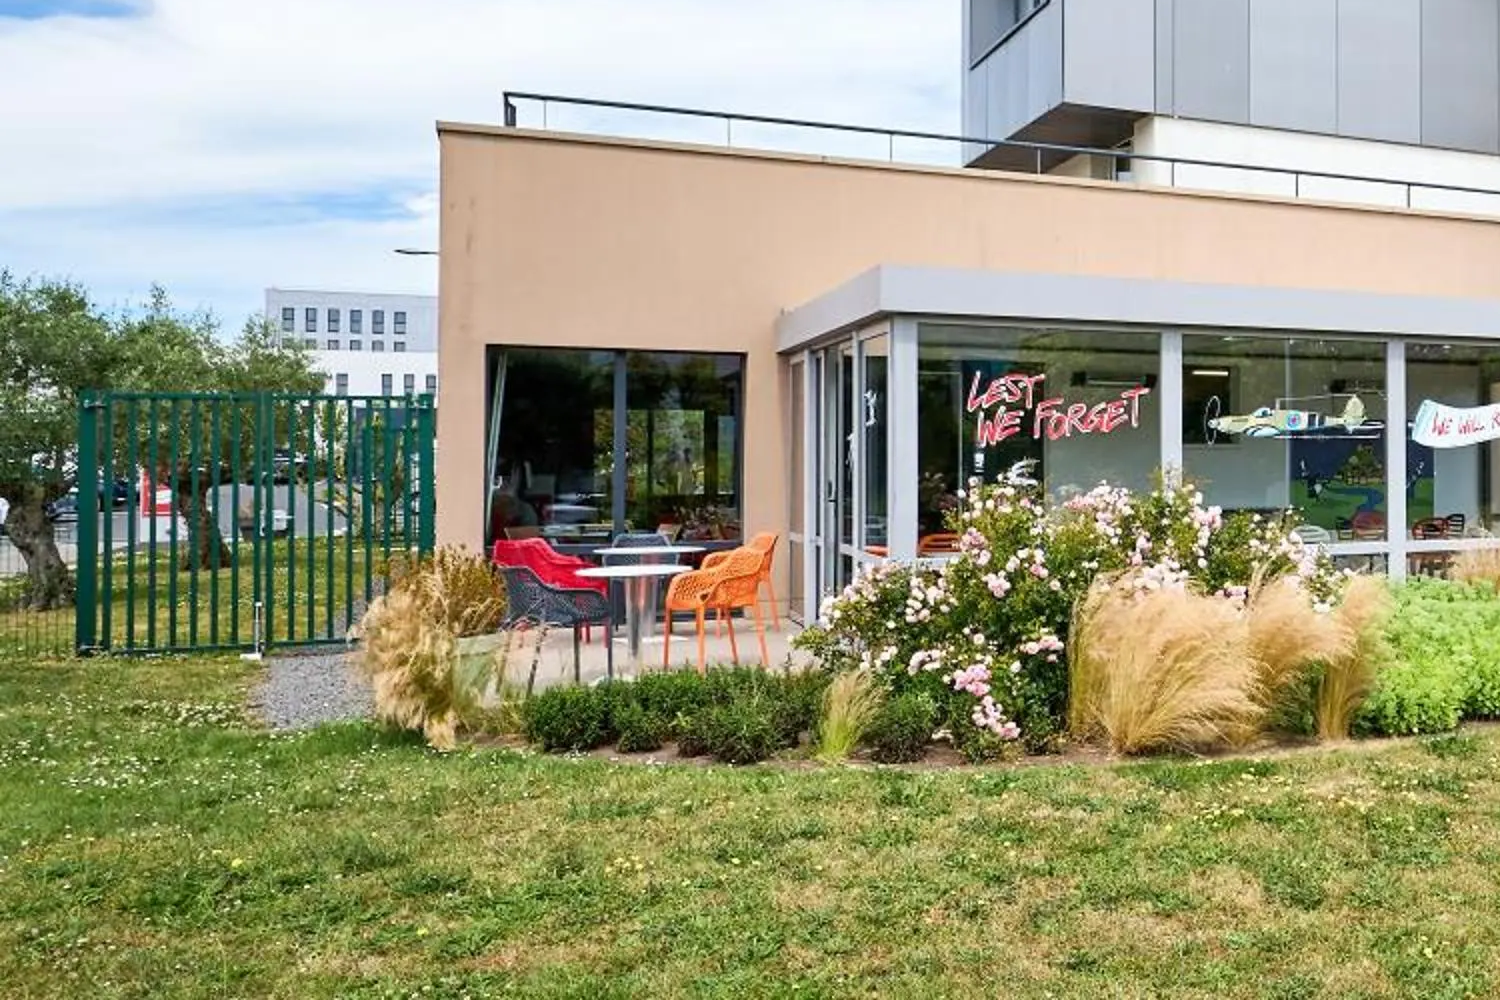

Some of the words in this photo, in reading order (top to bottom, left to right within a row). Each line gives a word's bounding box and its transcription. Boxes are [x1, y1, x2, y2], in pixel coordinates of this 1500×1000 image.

[967, 370, 1046, 412] LEST
[976, 405, 1025, 447] WE
[1033, 384, 1152, 441] FORGET
[1431, 410, 1454, 436] WE
